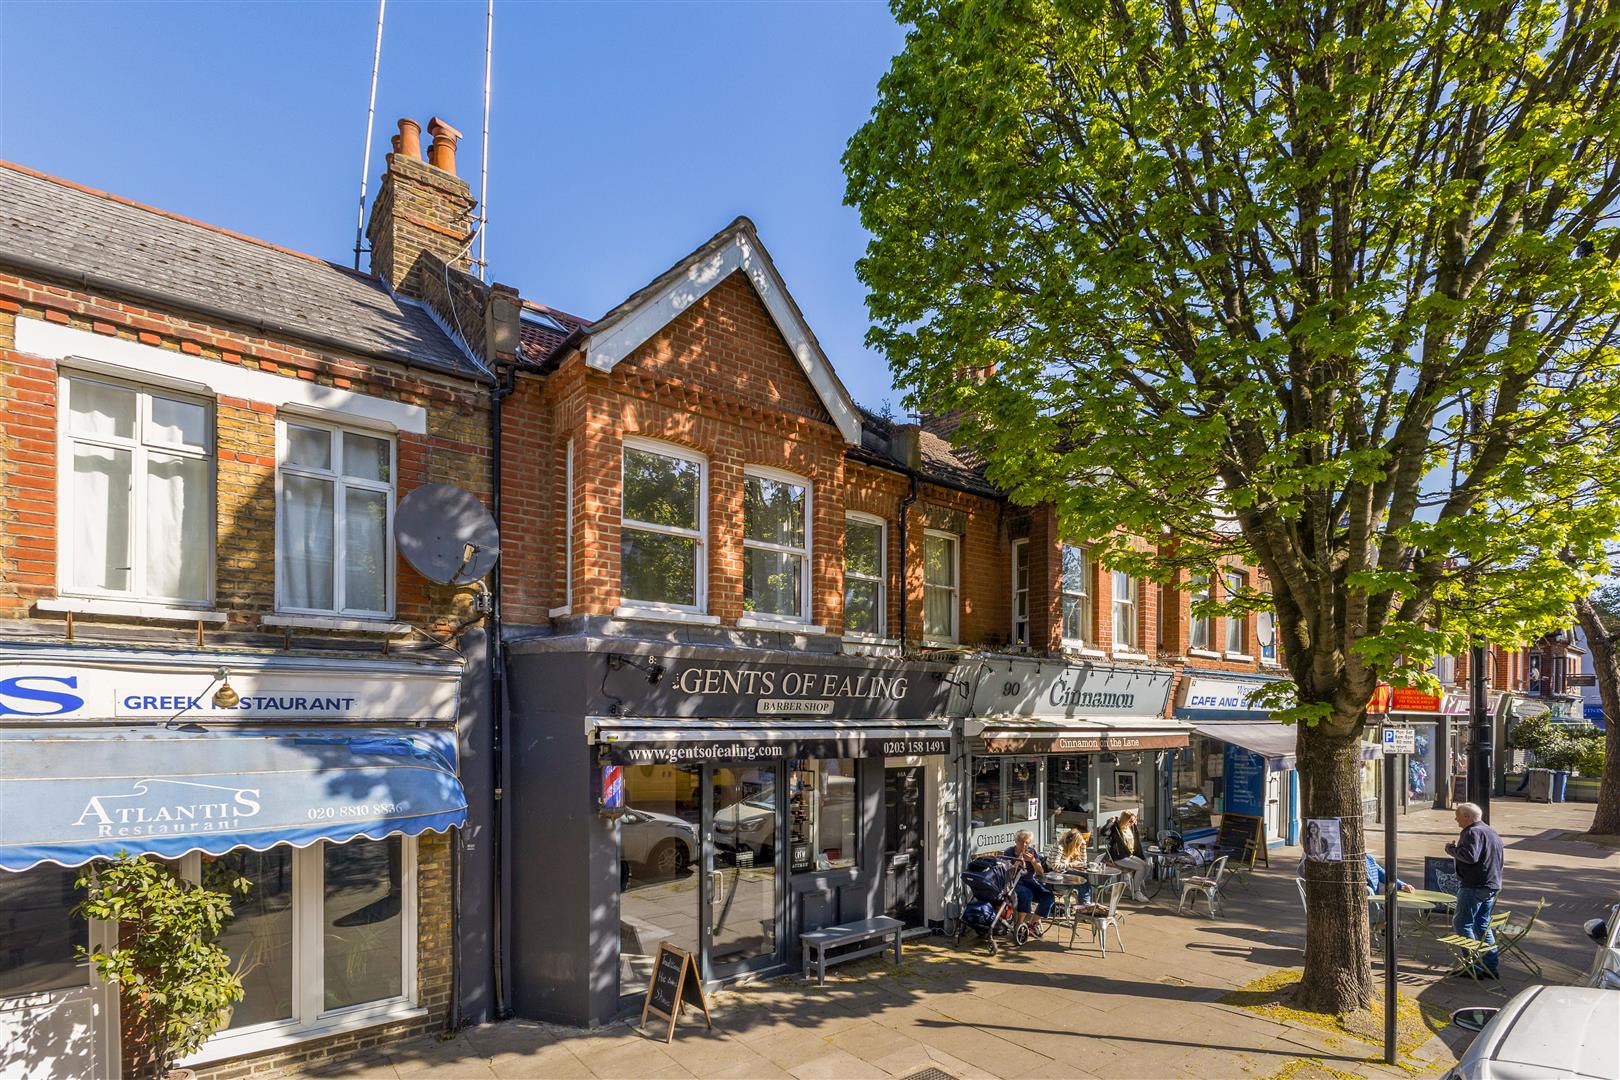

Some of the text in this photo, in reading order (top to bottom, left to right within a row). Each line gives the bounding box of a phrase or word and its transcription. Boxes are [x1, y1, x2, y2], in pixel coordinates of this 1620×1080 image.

[680, 668, 908, 699] GENTS OF EALING
[1003, 679, 1134, 708] 90 Cinnamon
[123, 695, 355, 711] GREEK STAURANT
[762, 701, 829, 711] BARBER SHOP
[1191, 696, 1217, 706] CAFE
[1218, 697, 1239, 707] AND
[628, 740, 946, 763] www.gentsofealing.com 0203 158 1491
[1059, 739, 1098, 748] Cinnamon
[1110, 738, 1122, 747] the
[71, 788, 261, 826] ATLANTIS
[98, 803, 403, 838] Restaurant 020 8810 8836
[976, 831, 1015, 848] Cinnam
